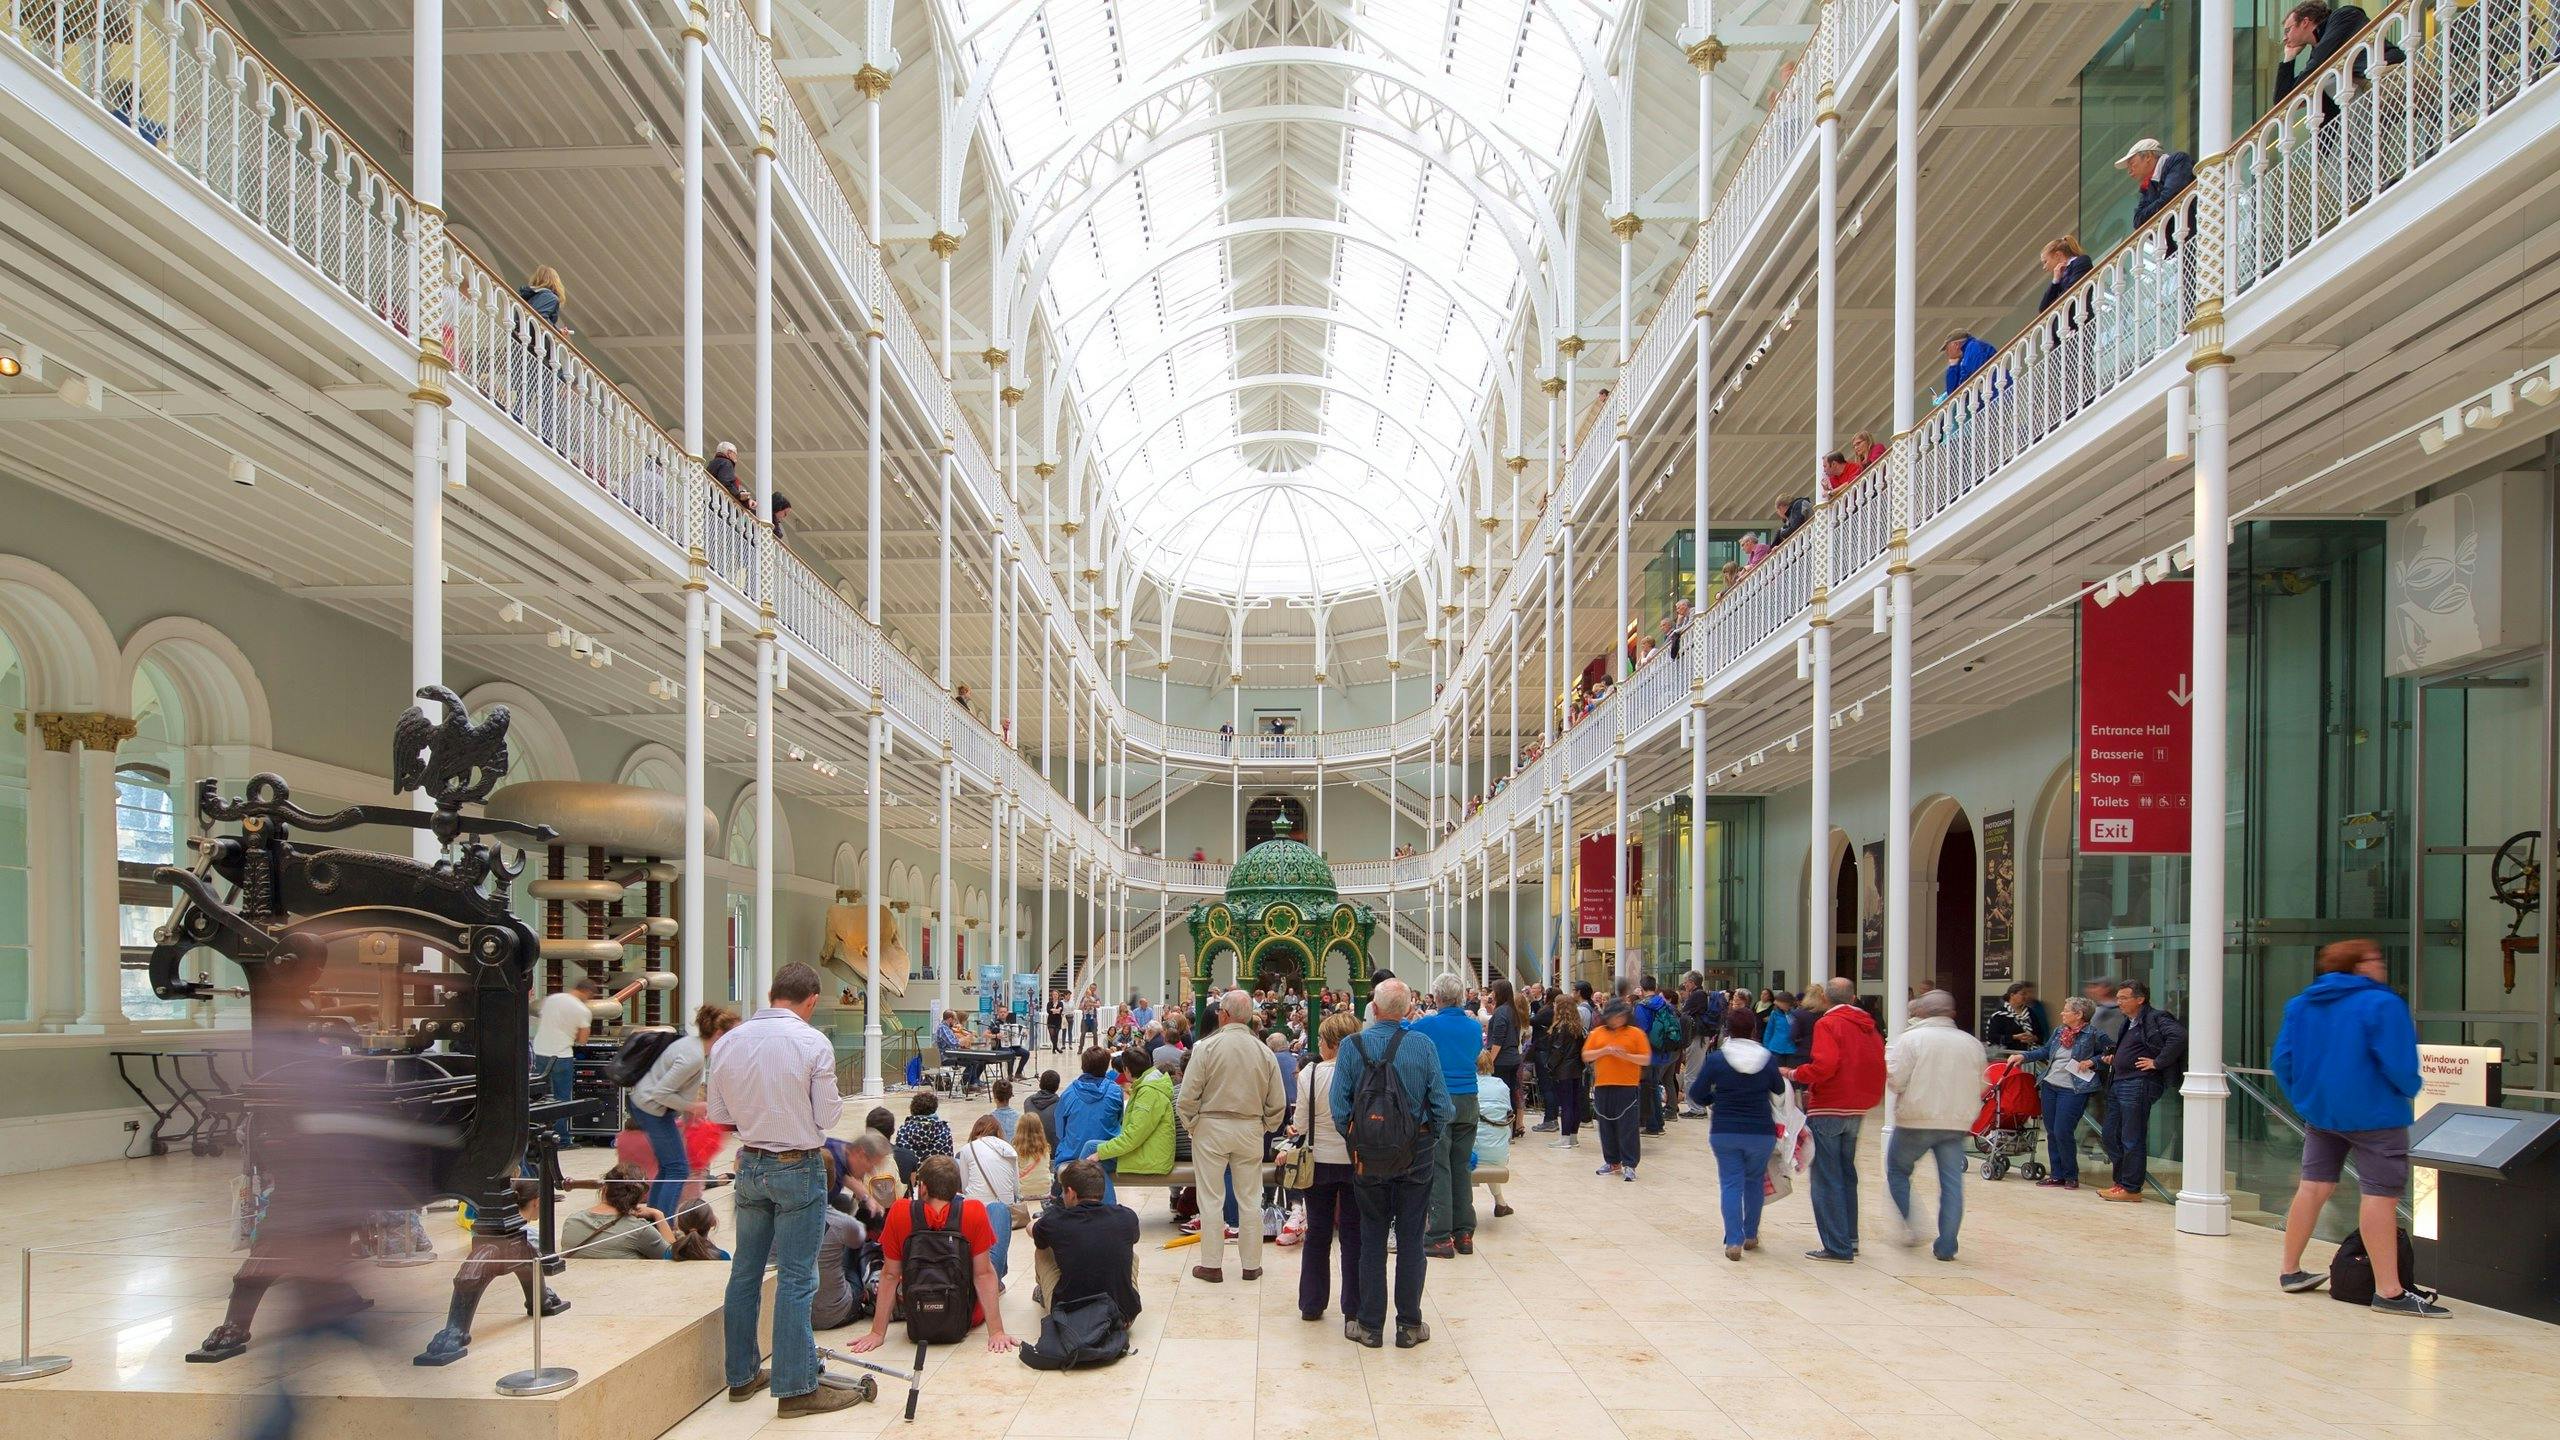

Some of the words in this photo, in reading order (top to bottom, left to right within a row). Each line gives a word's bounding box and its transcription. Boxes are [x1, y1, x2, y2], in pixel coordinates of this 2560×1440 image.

[2091, 725, 2144, 736] Entrance
[2146, 725, 2170, 736] Hall
[2091, 749, 2144, 759] Brasserie
[2090, 773, 2120, 786] Shop
[2090, 796, 2129, 807] Toilets
[2094, 823, 2128, 838] Exit
[2422, 1054, 2456, 1064] Window
[2458, 1057, 2469, 1065] on
[2422, 1065, 2436, 1074] the
[2437, 1065, 2463, 1075] World
